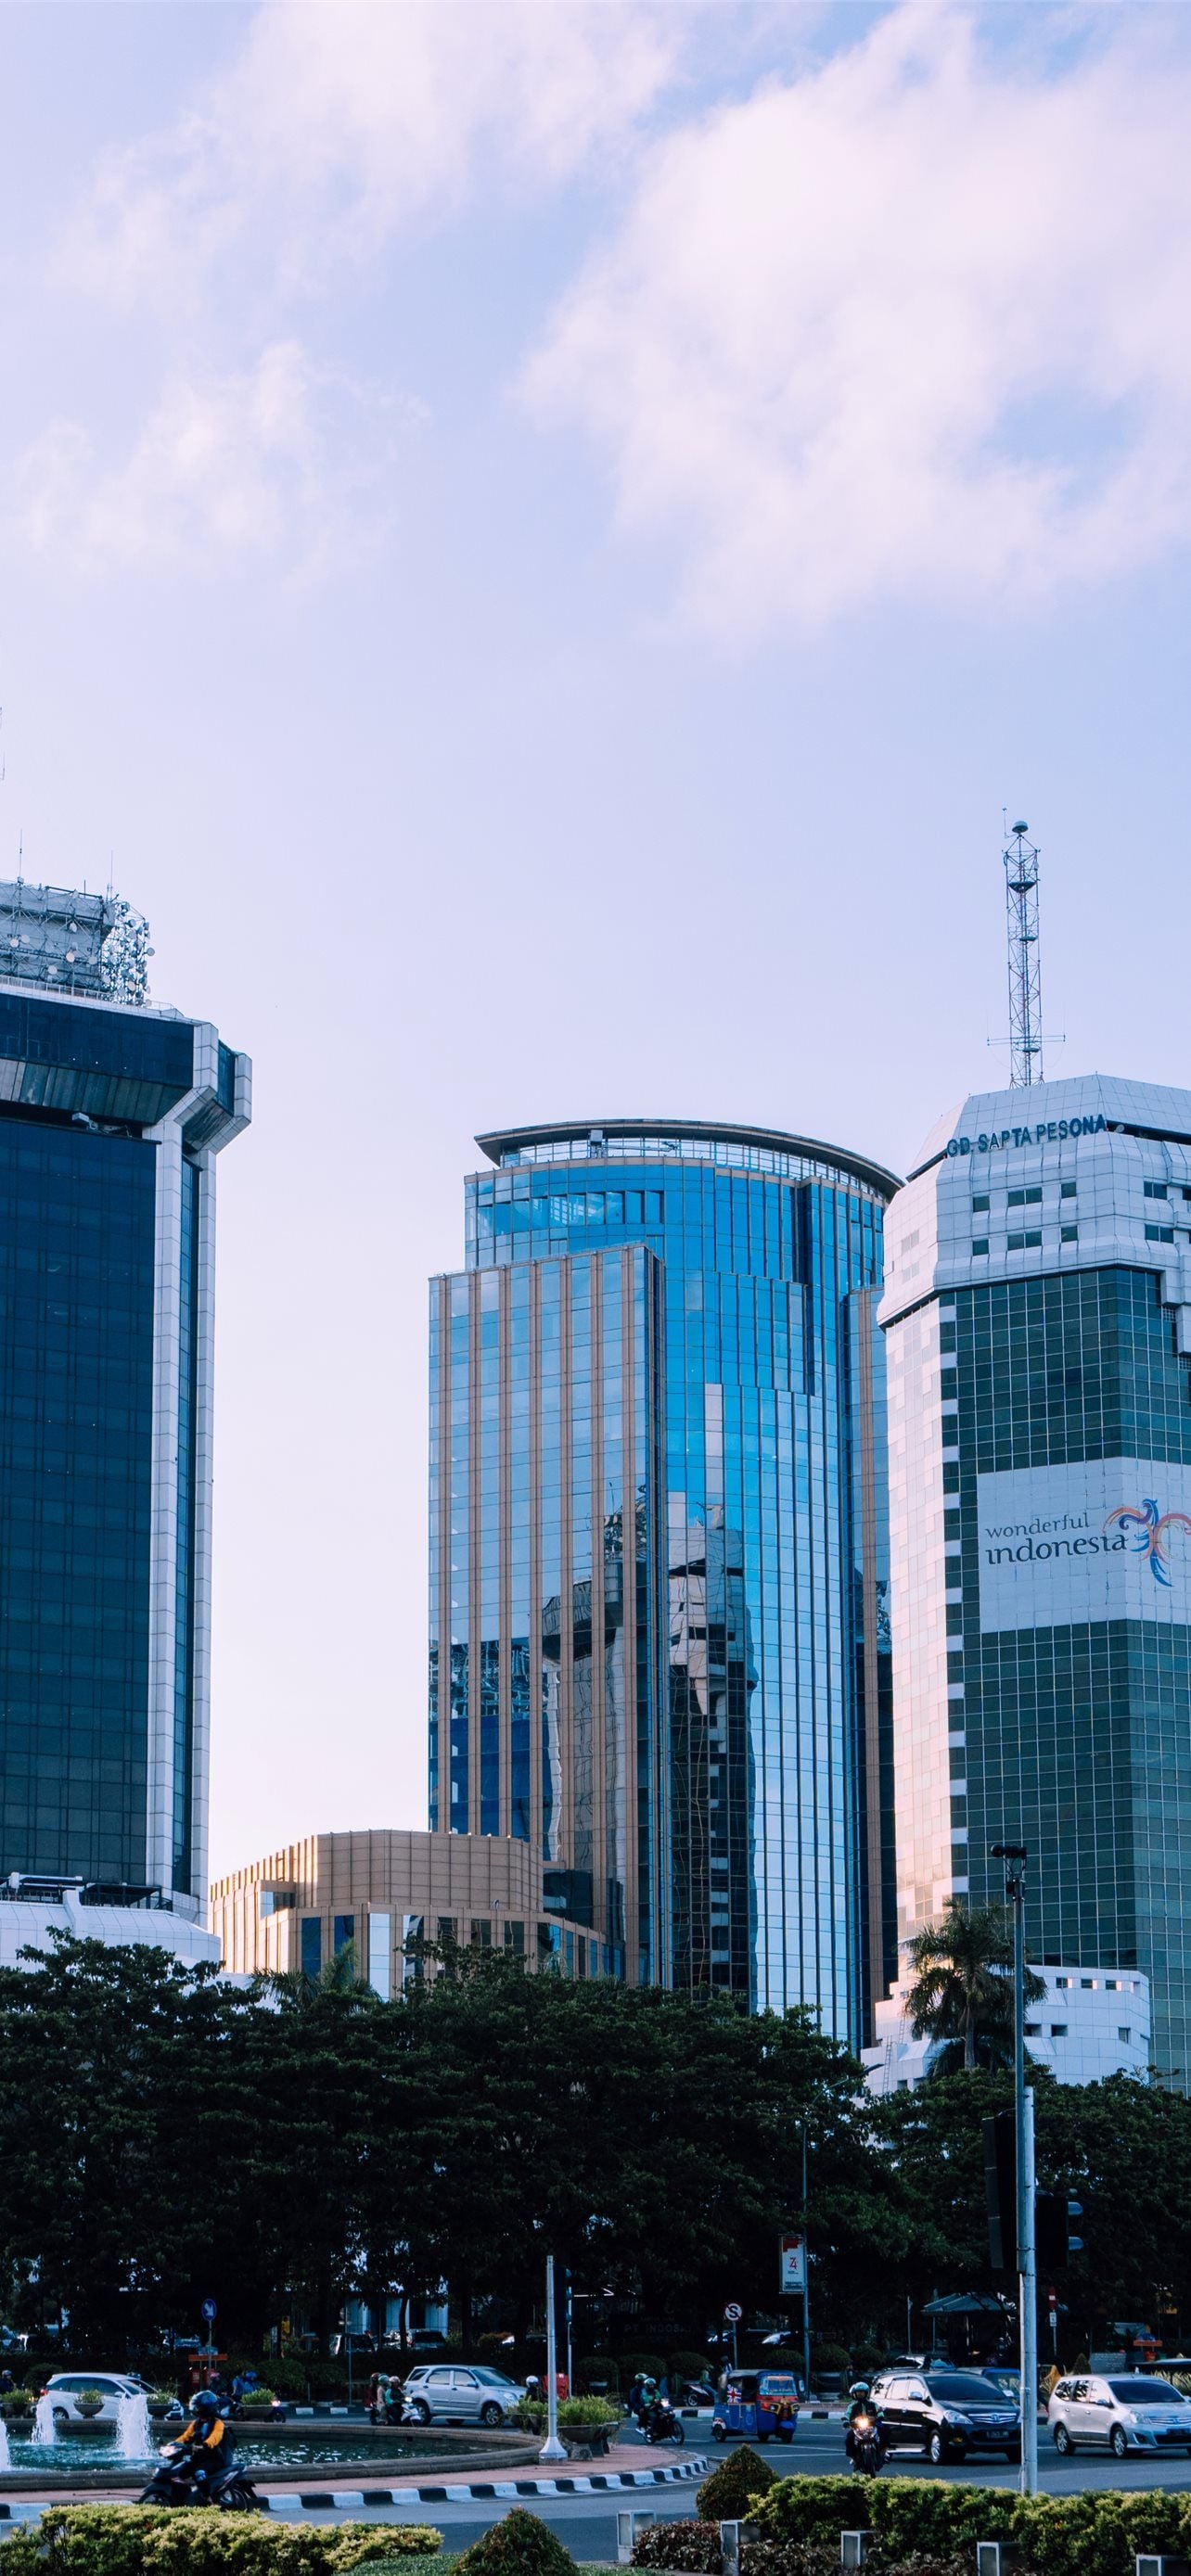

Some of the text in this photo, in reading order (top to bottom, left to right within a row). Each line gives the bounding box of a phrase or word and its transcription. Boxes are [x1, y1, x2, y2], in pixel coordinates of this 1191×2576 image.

[978, 1127, 1031, 1153] SAPTA
[1036, 1114, 1106, 1141] PESONA
[985, 1512, 1129, 1564] wonderful indonesia
